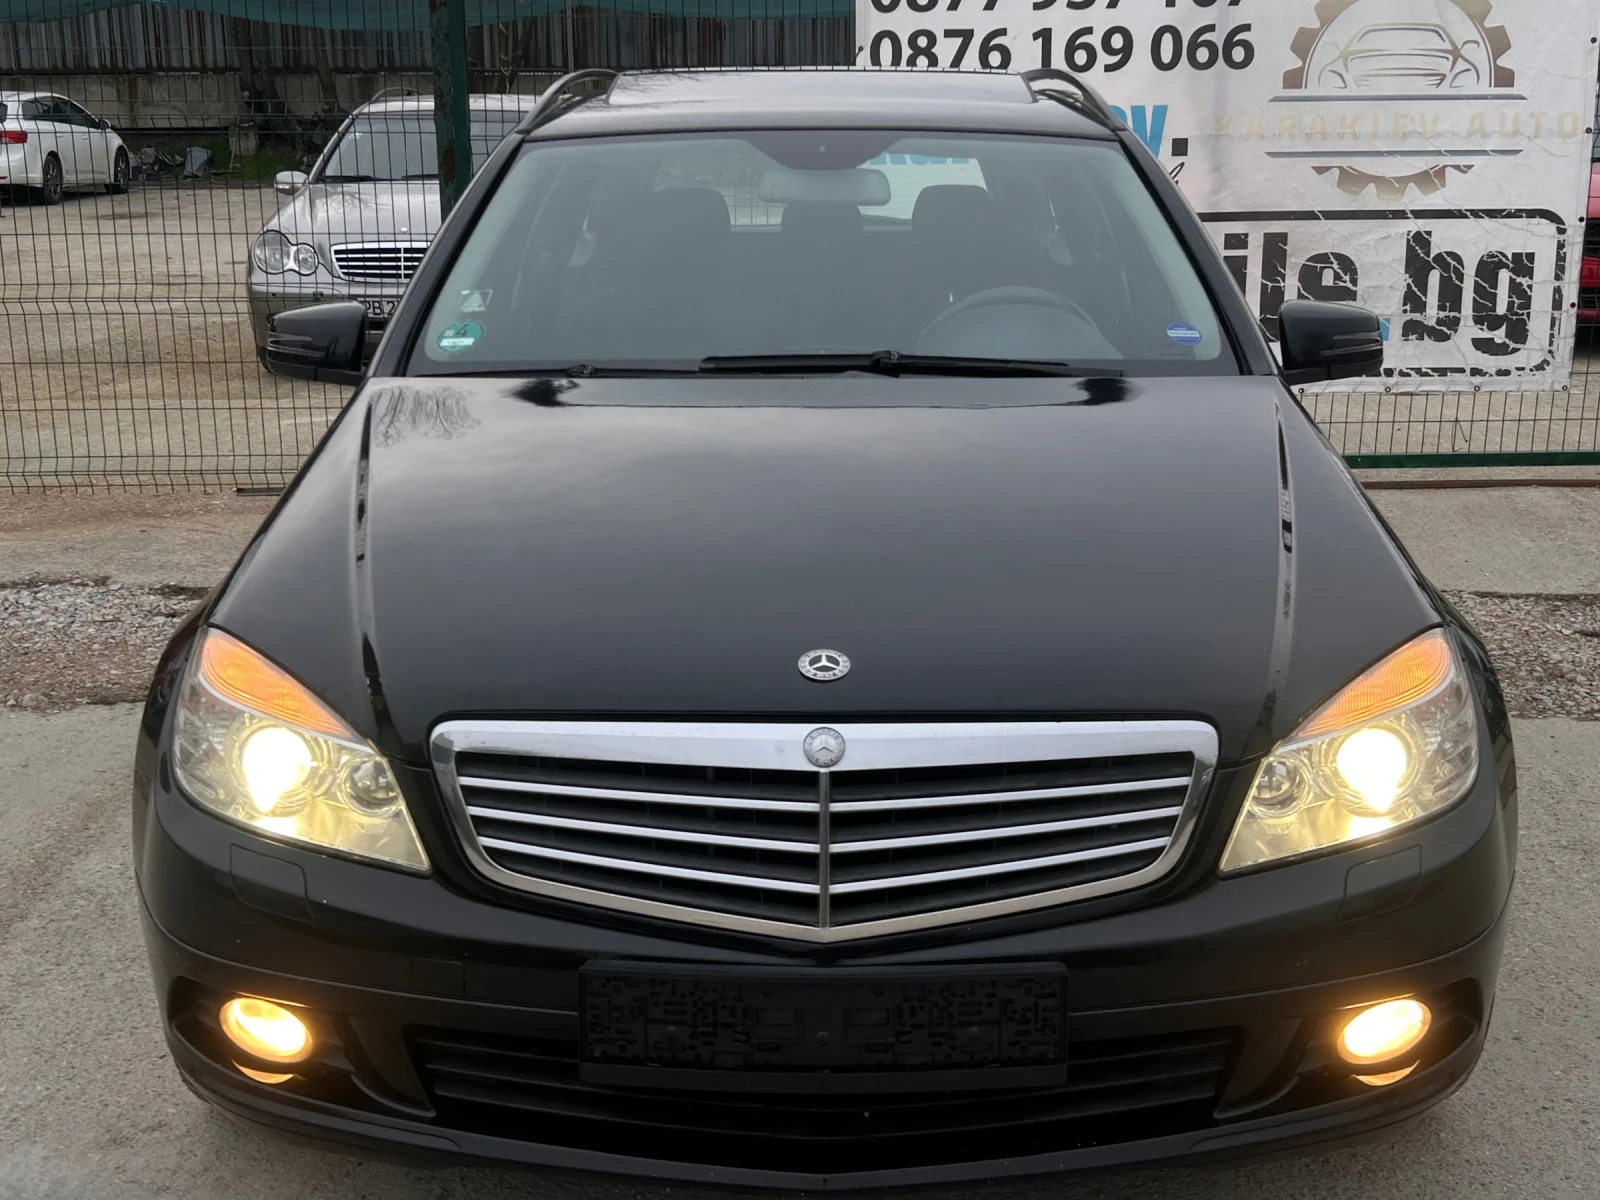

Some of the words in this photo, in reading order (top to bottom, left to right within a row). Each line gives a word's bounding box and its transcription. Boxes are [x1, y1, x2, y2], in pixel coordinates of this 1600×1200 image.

[869, 28, 1012, 70] 0876
[1032, 26, 1134, 73] 169
[1150, 23, 1255, 71] 066
[1213, 112, 1441, 142] KARAKIEV
[1464, 111, 1581, 140] AUTO
